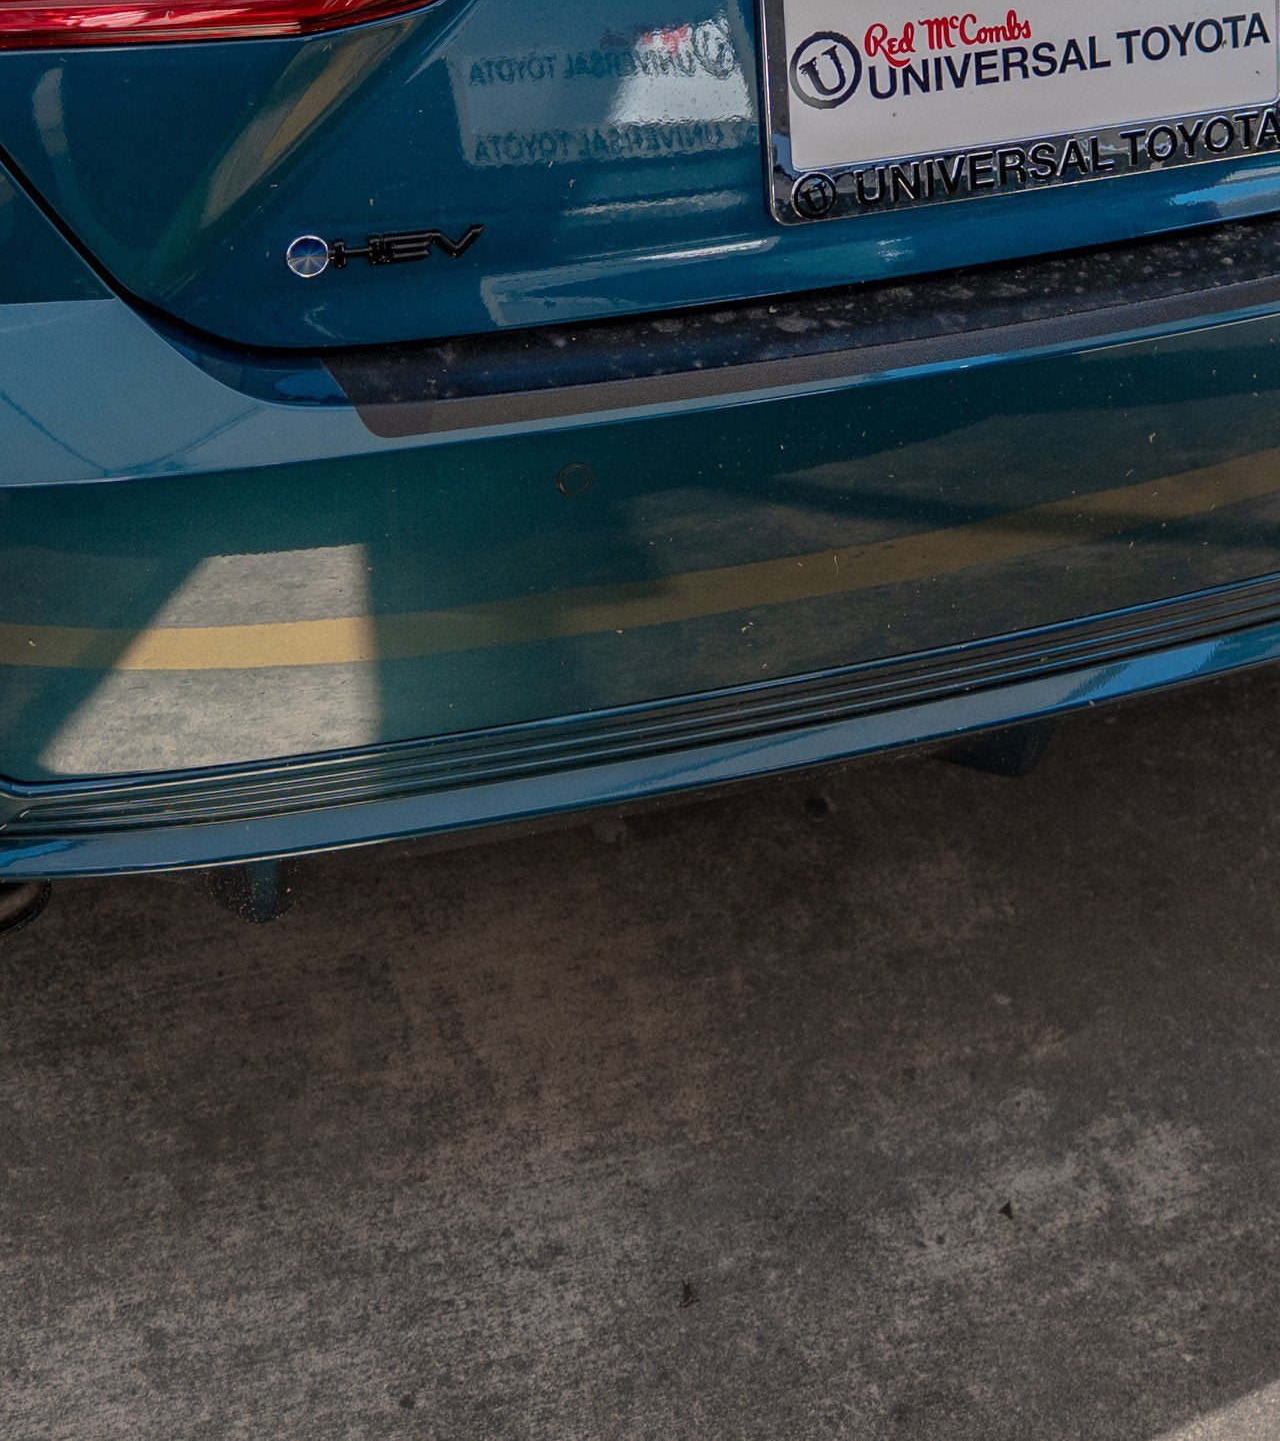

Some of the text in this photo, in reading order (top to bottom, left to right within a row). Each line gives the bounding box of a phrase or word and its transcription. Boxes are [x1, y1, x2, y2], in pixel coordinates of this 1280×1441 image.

[864, 9, 1032, 68] Red McCombs
[868, 12, 1270, 99] UNIVERSAL TOYOTA
[853, 135, 1115, 206] UNIVERSAL
[328, 223, 485, 269] HEV
